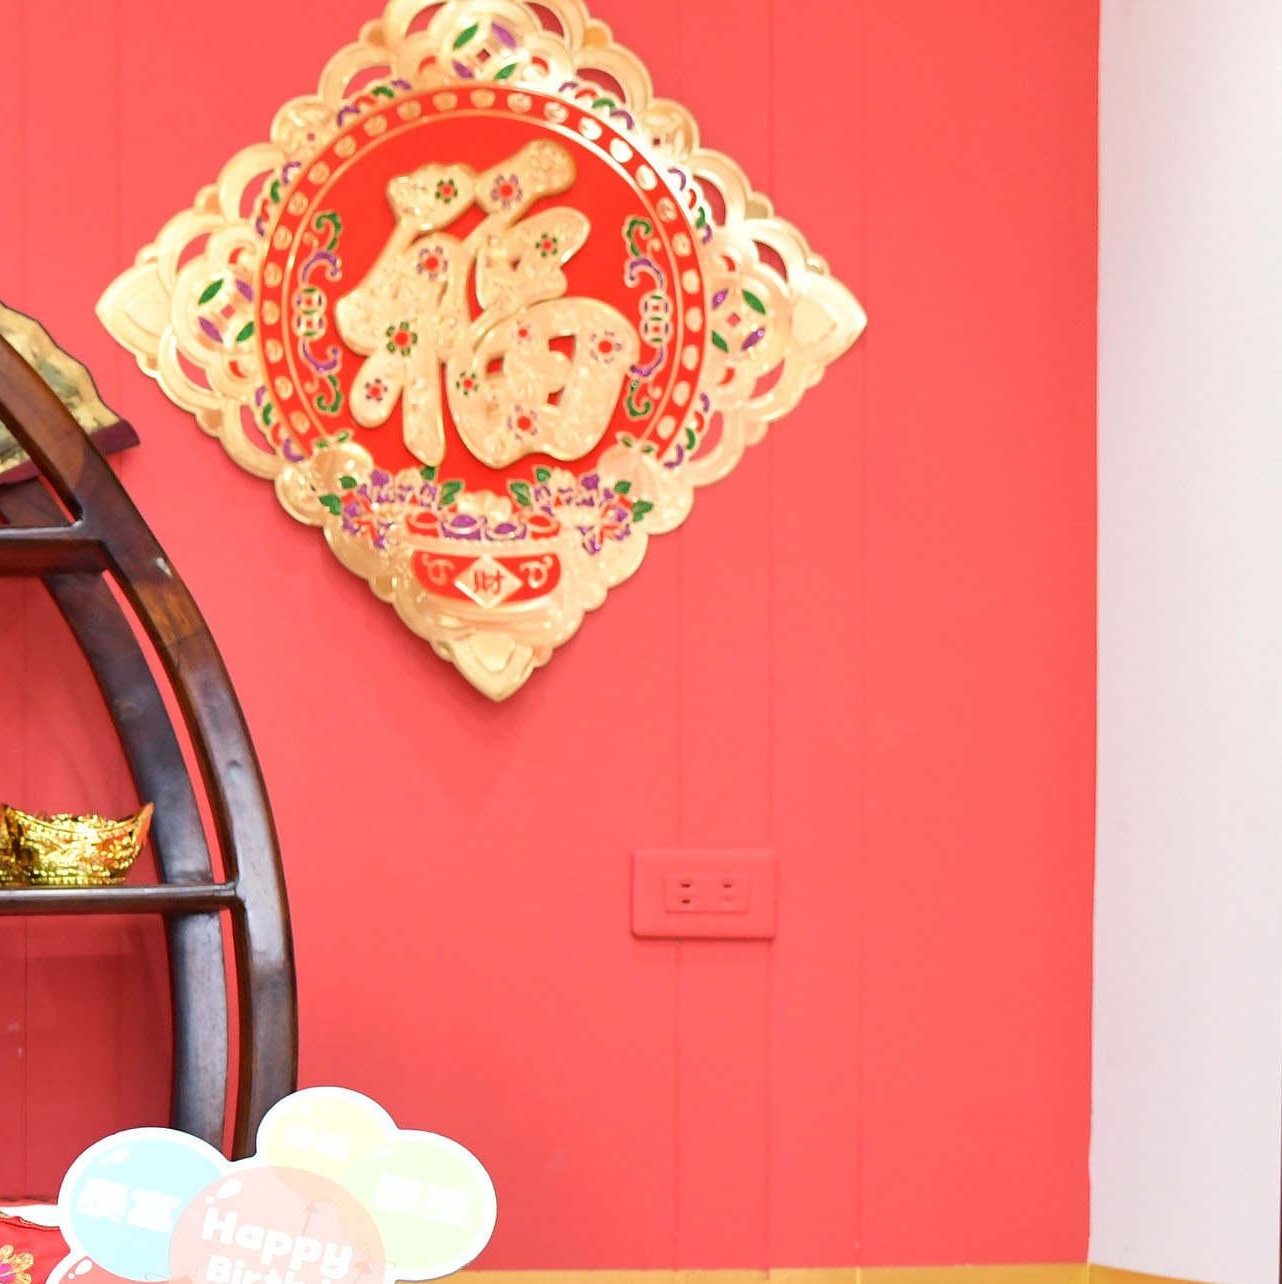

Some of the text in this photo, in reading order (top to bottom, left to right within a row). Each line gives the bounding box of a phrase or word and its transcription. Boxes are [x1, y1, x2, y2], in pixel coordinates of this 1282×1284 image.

[335, 138, 638, 469] 福
[473, 569, 503, 594] 財
[200, 1204, 353, 1280] Happy
